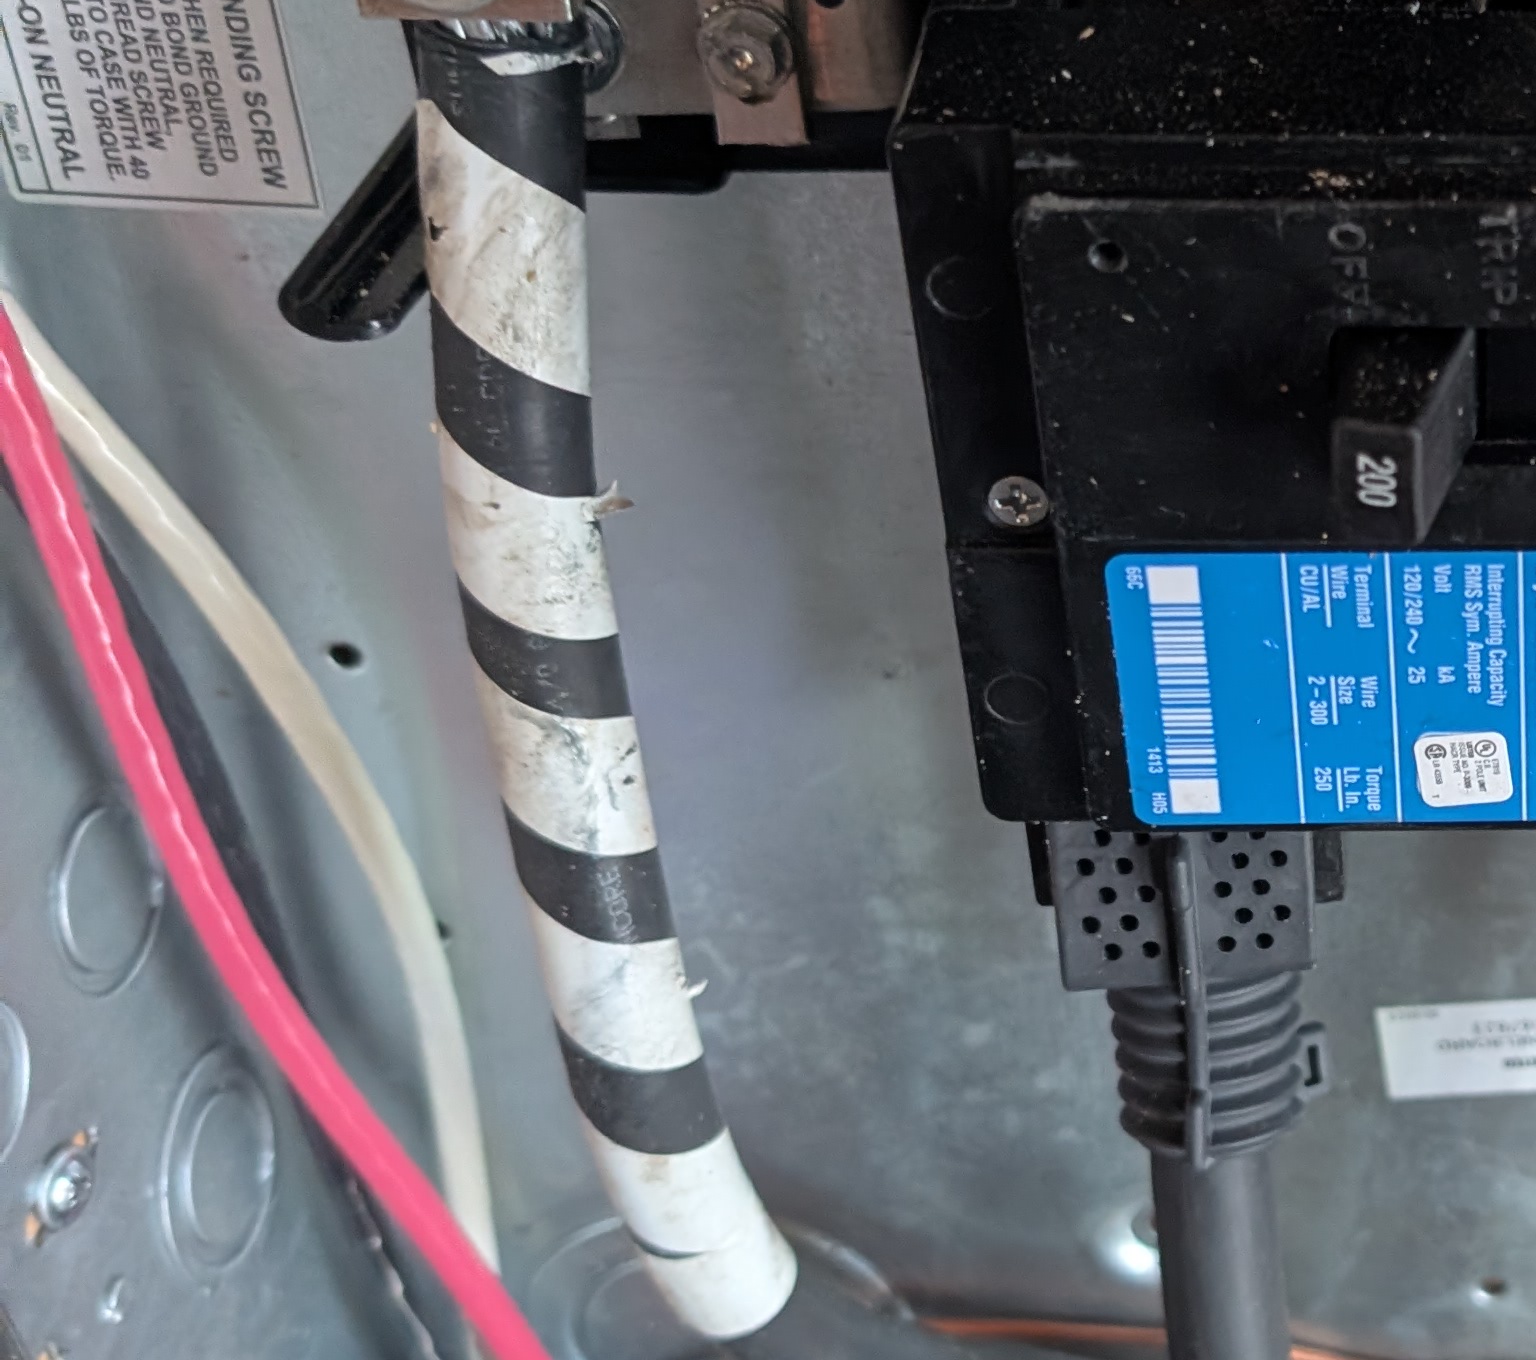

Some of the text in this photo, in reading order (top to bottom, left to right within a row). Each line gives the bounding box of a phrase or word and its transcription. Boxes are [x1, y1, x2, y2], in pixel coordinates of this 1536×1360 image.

[30, 53, 87, 181] NEUTRAL
[76, 50, 101, 80] OF
[94, 30, 128, 91] CASE
[111, 97, 145, 151] WITH
[129, 156, 151, 181] 40
[127, 71, 168, 151] SCREW
[160, 12, 193, 77] BOND
[179, 82, 219, 177] GROUND
[194, 50, 240, 164] REQUIRED
[86, 86, 128, 183] TORQUE.
[242, 91, 289, 190] SCREW
[1356, 453, 1398, 508] 200
[1299, 564, 1321, 614] CU/AL
[1315, 767, 1334, 793] 250
[1408, 667, 1427, 686] 25
[1433, 564, 1457, 685] Volt kA
[1461, 564, 1485, 695] RMS Sym. Ampere
[1484, 564, 1508, 708] Interrupting Capacity
[1331, 564, 1363, 810] Wire Size Lb. In.
[1354, 564, 1385, 814] Terminal Wire Torque
[1147, 747, 1165, 775] 1413
